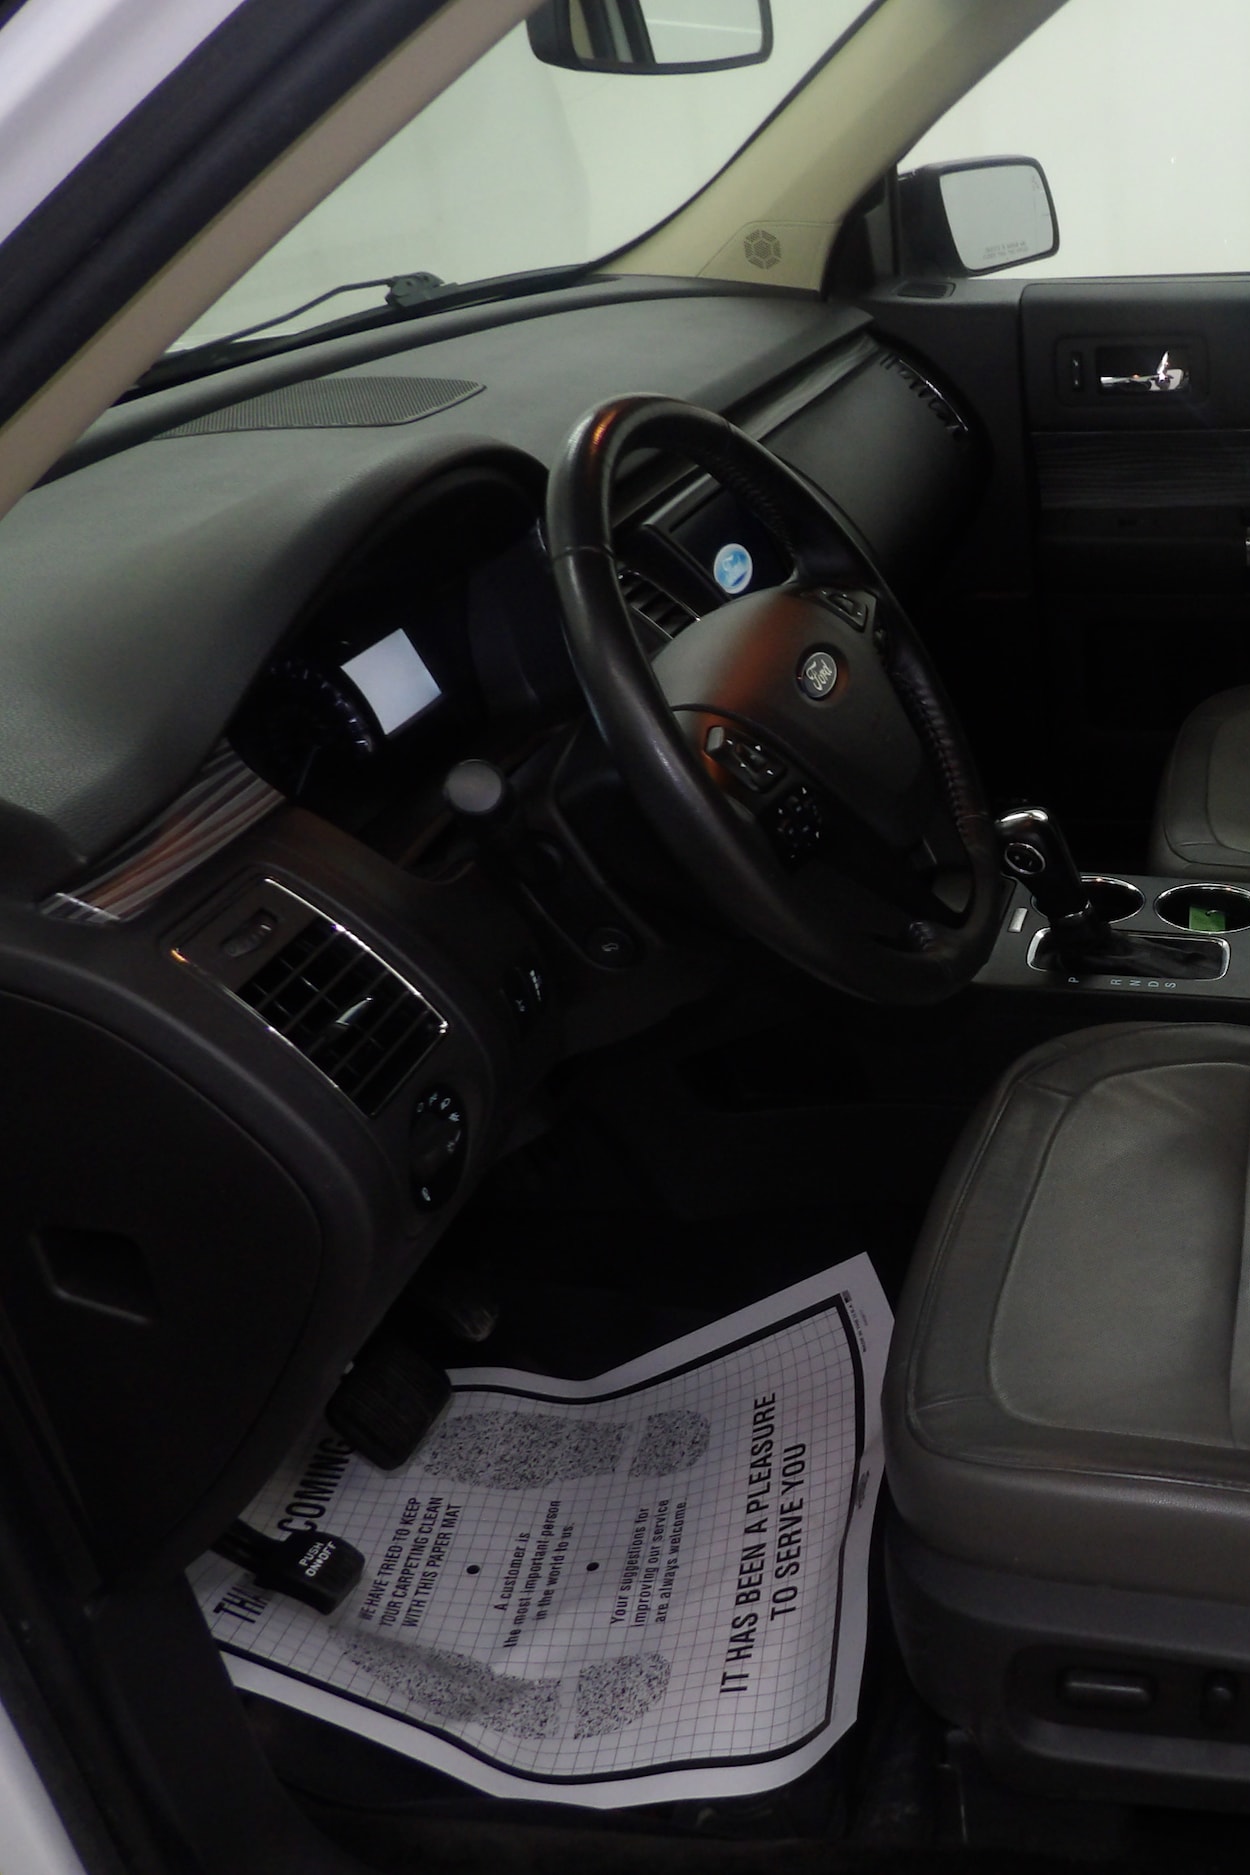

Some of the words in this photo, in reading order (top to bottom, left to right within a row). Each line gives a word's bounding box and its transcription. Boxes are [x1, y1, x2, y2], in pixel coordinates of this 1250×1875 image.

[806, 660, 832, 691] Ford
[1147, 980, 1160, 988] D
[747, 1392, 776, 1515] PLEASURE
[780, 1443, 806, 1496] YOU
[400, 1497, 420, 1525] KEEP
[418, 1497, 444, 1534] CLEAN
[541, 1501, 561, 1536] person
[653, 1499, 669, 1542] service
[669, 1497, 687, 1555] welcome.
[744, 1517, 768, 1535] A
[392, 1529, 410, 1541] TO
[515, 1532, 530, 1542] is
[562, 1522, 575, 1538] us.
[775, 1497, 803, 1579] SERVE
[299, 1542, 324, 1567] PUSH
[377, 1545, 403, 1576] TRIED
[553, 1542, 569, 1552] to
[648, 1546, 661, 1563] our
[391, 1537, 428, 1598] CARPETING
[402, 1600, 426, 1627] WITH
[415, 1571, 438, 1596] THIS
[427, 1533, 452, 1567] PAPER
[441, 1504, 462, 1528] MAT
[500, 1546, 526, 1599] customer
[520, 1540, 549, 1593] important
[546, 1555, 565, 1586] world
[610, 1596, 628, 1624] Your
[620, 1526, 646, 1591] suggestions
[634, 1508, 649, 1524] for
[659, 1558, 679, 1599] always
[735, 1542, 766, 1606] BEEN
[365, 1580, 389, 1607] HAVE
[494, 1603, 508, 1611] A
[537, 1590, 555, 1606] the
[629, 1567, 659, 1627] improving
[770, 1585, 799, 1621] TO
[380, 1601, 403, 1627] YOUR
[514, 1597, 532, 1625] most
[533, 1610, 548, 1620] in
[655, 1603, 669, 1624] are
[503, 1629, 522, 1648] the
[726, 1612, 758, 1663] HAS
[720, 1671, 750, 1694] IT
